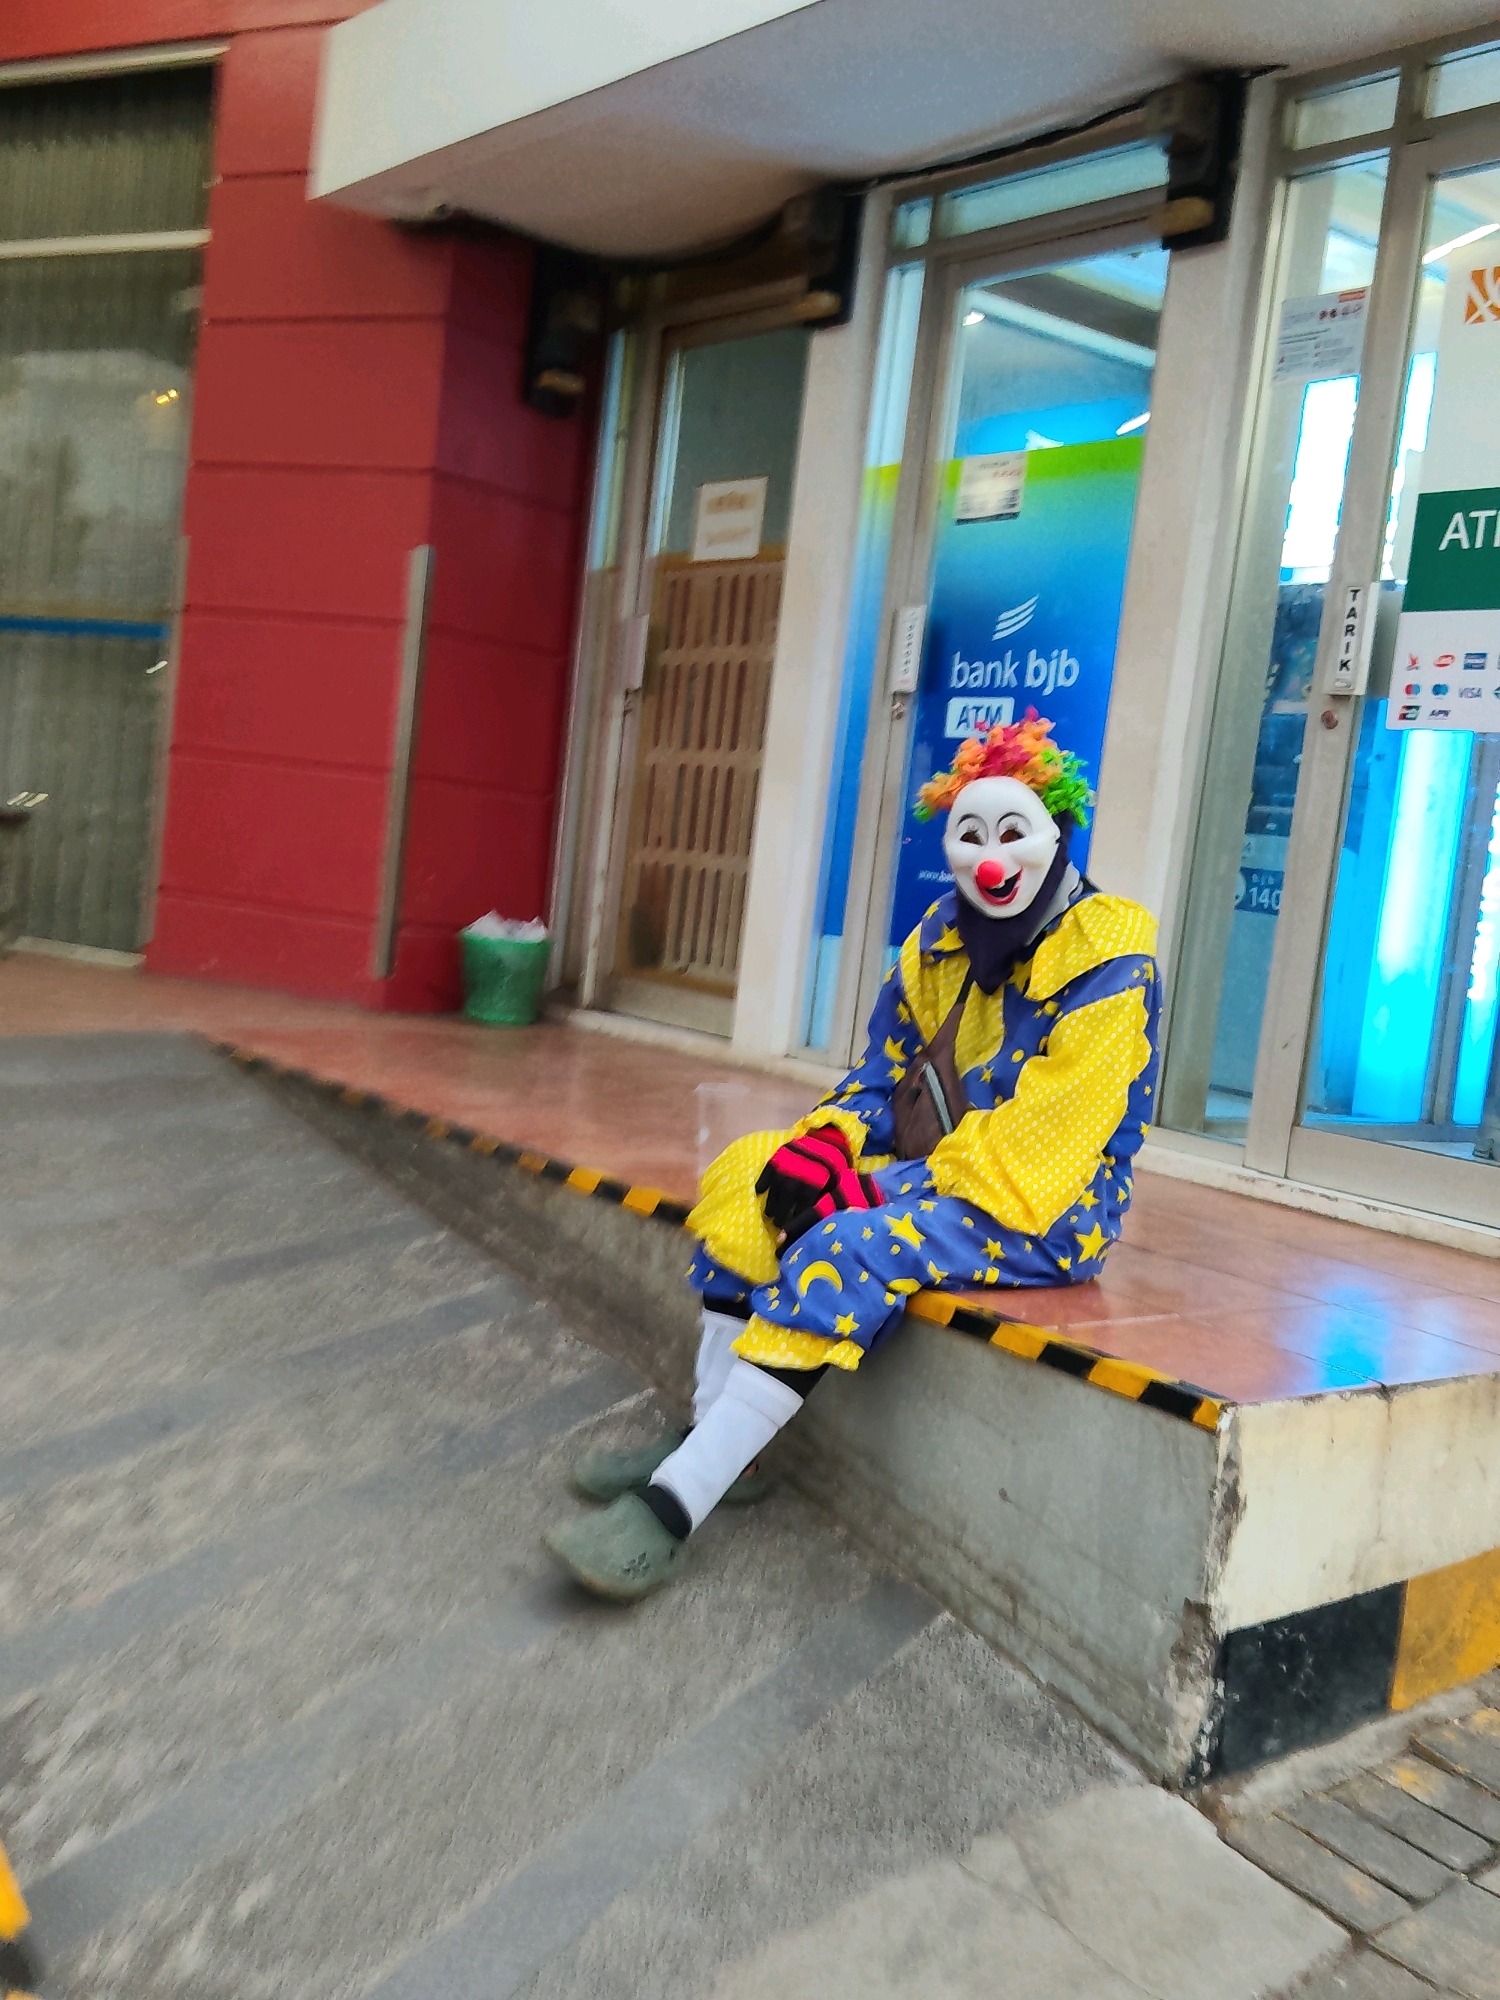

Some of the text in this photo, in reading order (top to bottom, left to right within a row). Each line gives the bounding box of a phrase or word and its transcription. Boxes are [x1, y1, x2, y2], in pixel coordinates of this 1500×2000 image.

[1438, 509, 1500, 551] AT
[1339, 588, 1361, 672] TARIK
[949, 648, 1080, 696] bank bjb
[955, 704, 1004, 731] ATM
